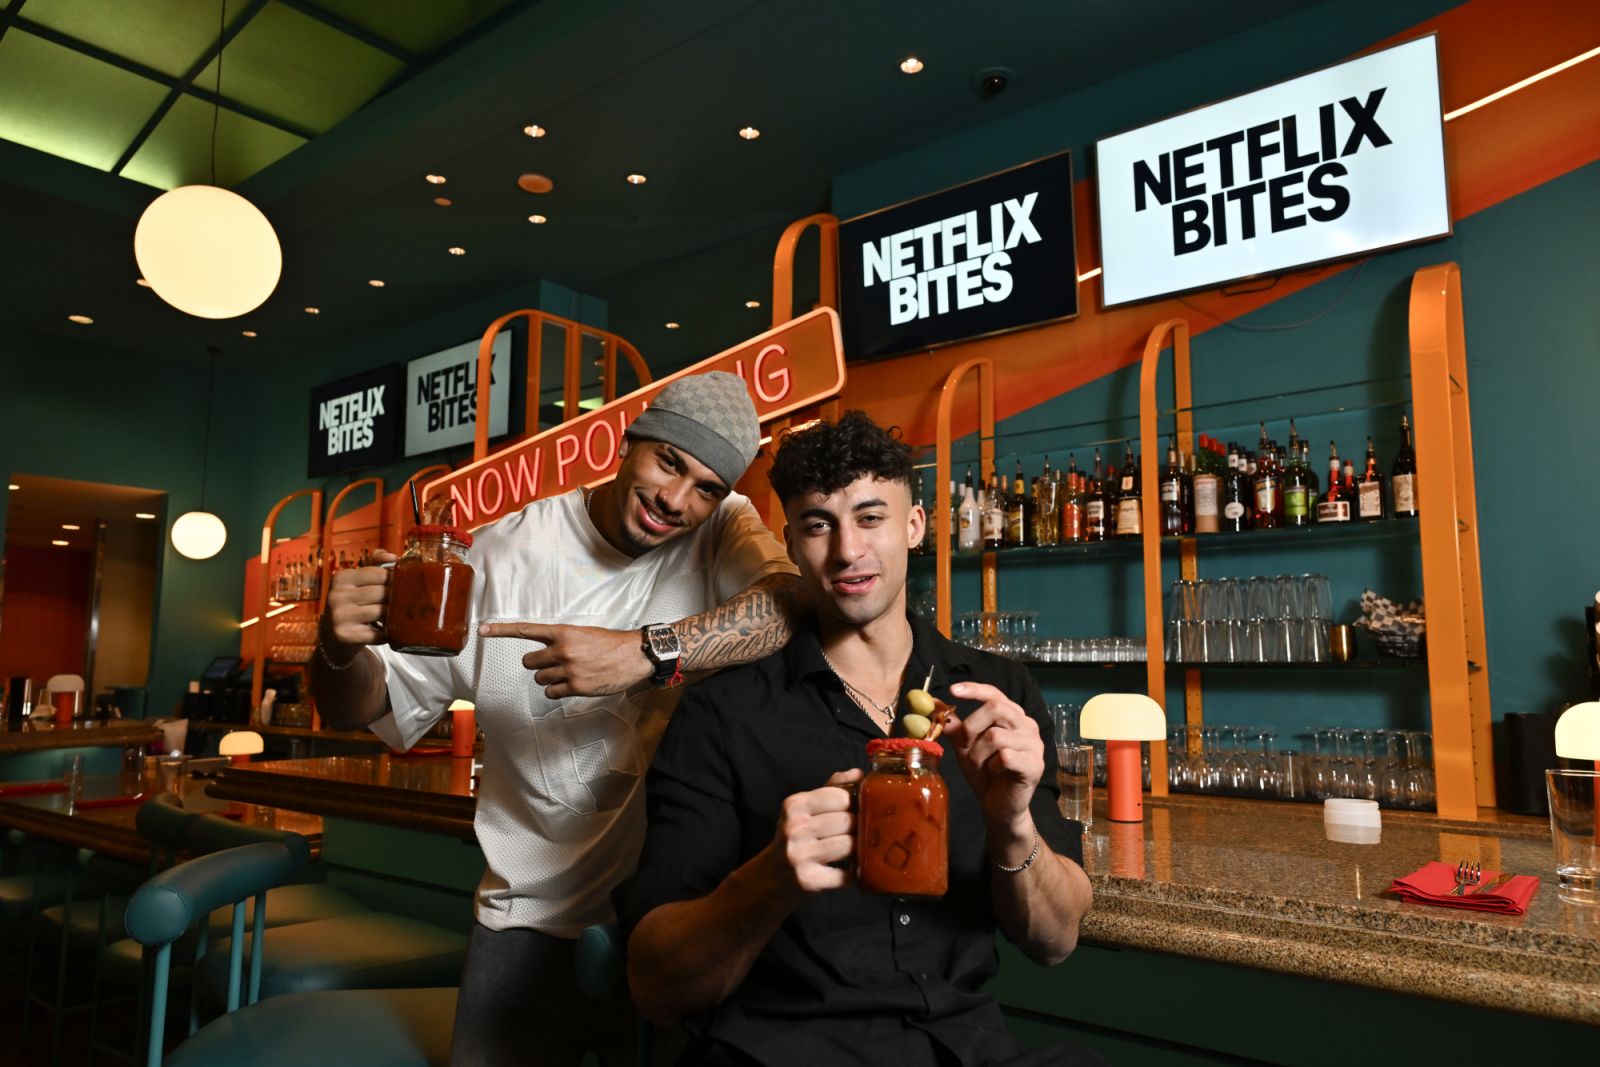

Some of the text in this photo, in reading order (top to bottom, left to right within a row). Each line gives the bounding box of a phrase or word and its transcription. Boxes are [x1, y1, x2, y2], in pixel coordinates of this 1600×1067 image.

[1132, 86, 1393, 213] NETFLIX
[862, 191, 1042, 288] NETFLIX
[1171, 161, 1351, 257] BITES
[889, 251, 1014, 327] BITES
[318, 384, 386, 431] NETFLIX
[327, 416, 375, 457] BITES
[449, 447, 541, 529] NOW
